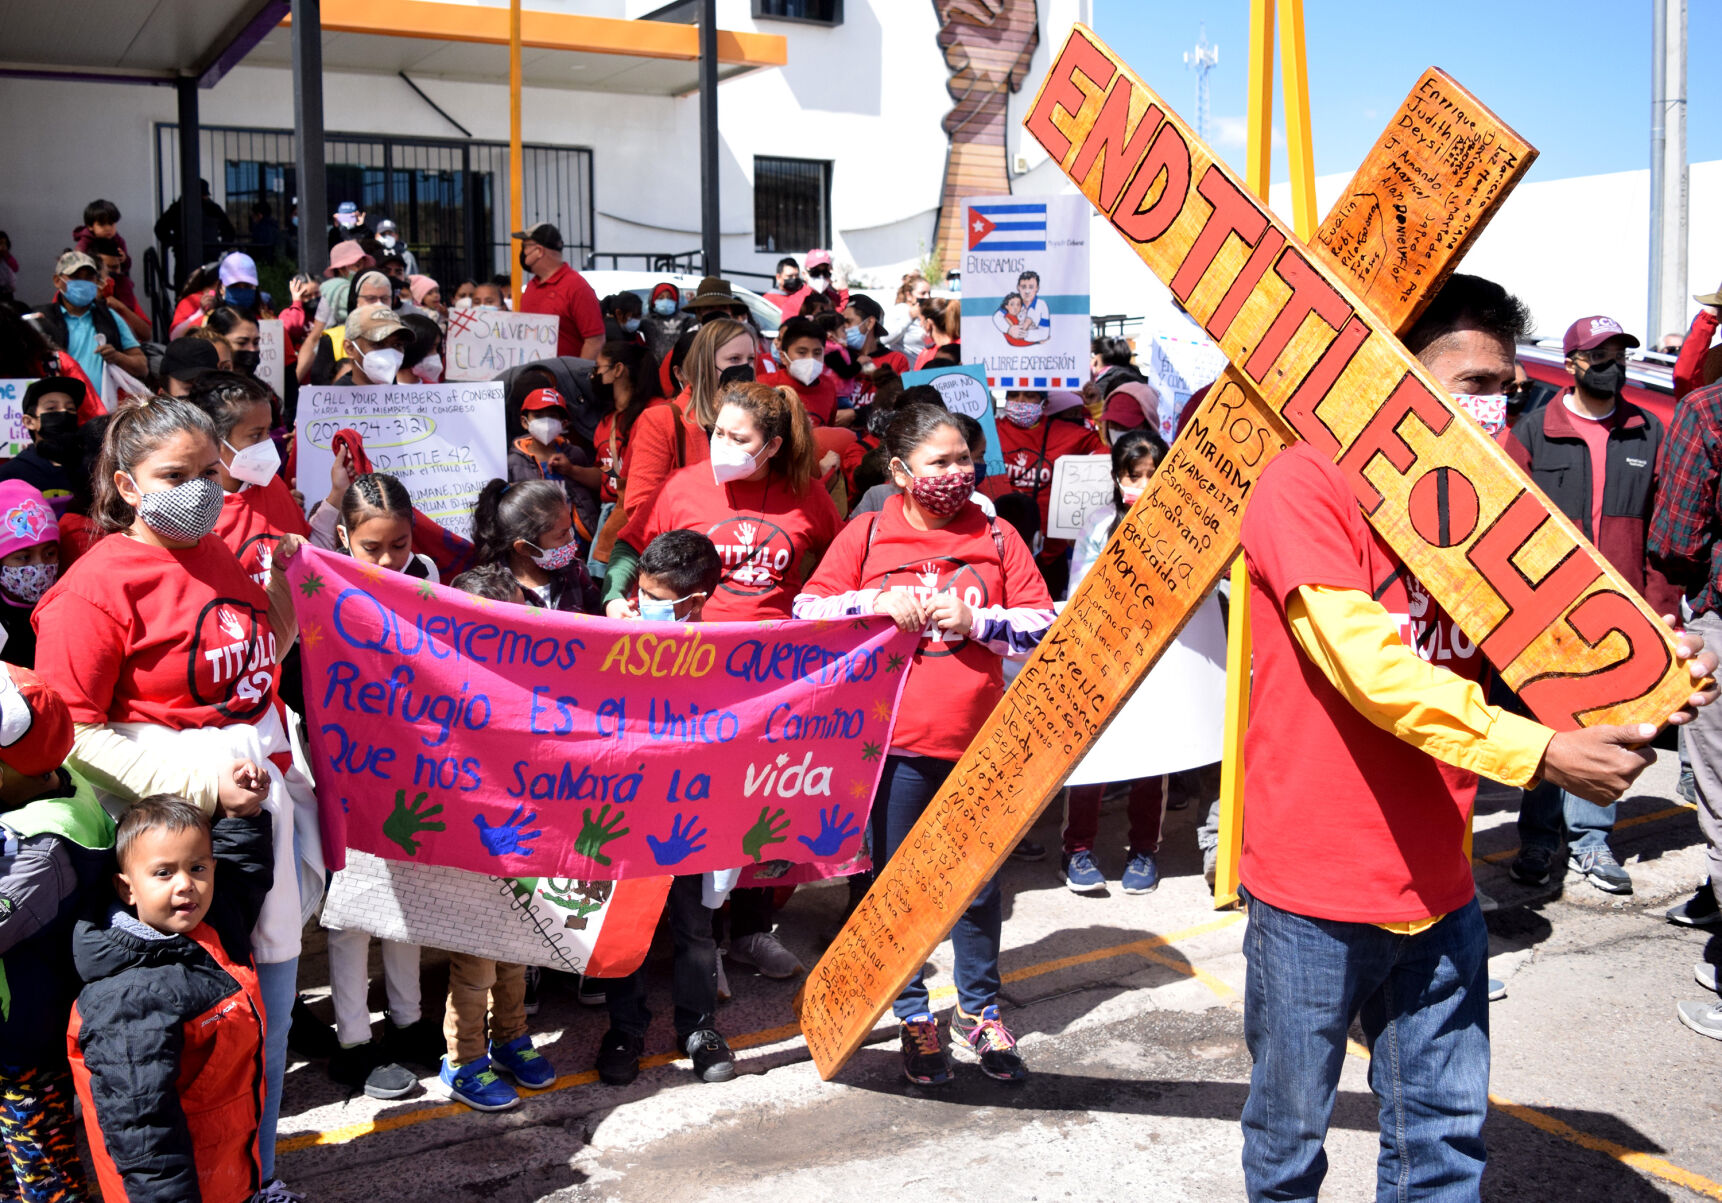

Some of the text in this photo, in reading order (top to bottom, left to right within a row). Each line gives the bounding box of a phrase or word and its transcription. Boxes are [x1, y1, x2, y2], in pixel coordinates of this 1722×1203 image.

[1399, 114, 1444, 154] Deysi
[1407, 95, 1453, 138] Judith
[1025, 31, 1193, 244] END
[1380, 177, 1404, 201] Alan
[1386, 162, 1430, 200] Marisol
[1479, 154, 1517, 209] Maricela
[1331, 232, 1352, 258] Rubi
[967, 255, 1025, 274] BUSCAMOS
[991, 356, 1018, 371] LIBRE
[1020, 352, 1075, 371] EXPRESIÓN
[312, 391, 345, 407] CALL
[351, 391, 378, 405] YOUR
[385, 390, 442, 405] MEMBERS
[353, 406, 367, 414] TUS
[432, 405, 475, 414] CONGRESO
[954, 389, 969, 402] UN
[397, 449, 440, 469] TITLE
[448, 446, 475, 463] 42
[464, 463, 479, 473] 42
[1184, 416, 1253, 500] MIRIAM
[1159, 462, 1222, 534] Esmeralda
[1170, 446, 1241, 517] EVANGELITA
[714, 544, 789, 571] TITULO
[733, 565, 774, 587] 42
[1105, 538, 1156, 608] Monce
[1121, 522, 1177, 592] Betzaida
[333, 588, 586, 671] Queremos
[1140, 618, 1152, 639] R
[205, 632, 276, 683] TITULO
[237, 671, 273, 704] 42
[323, 661, 492, 747] Refugio
[530, 686, 579, 736] Es
[649, 698, 739, 744] Unico
[766, 701, 865, 743] Camino
[1024, 665, 1082, 741] Emerson
[1022, 710, 1053, 749] Eduardo
[321, 723, 397, 779] Que
[413, 752, 482, 792] nos
[881, 891, 898, 918] Ana
